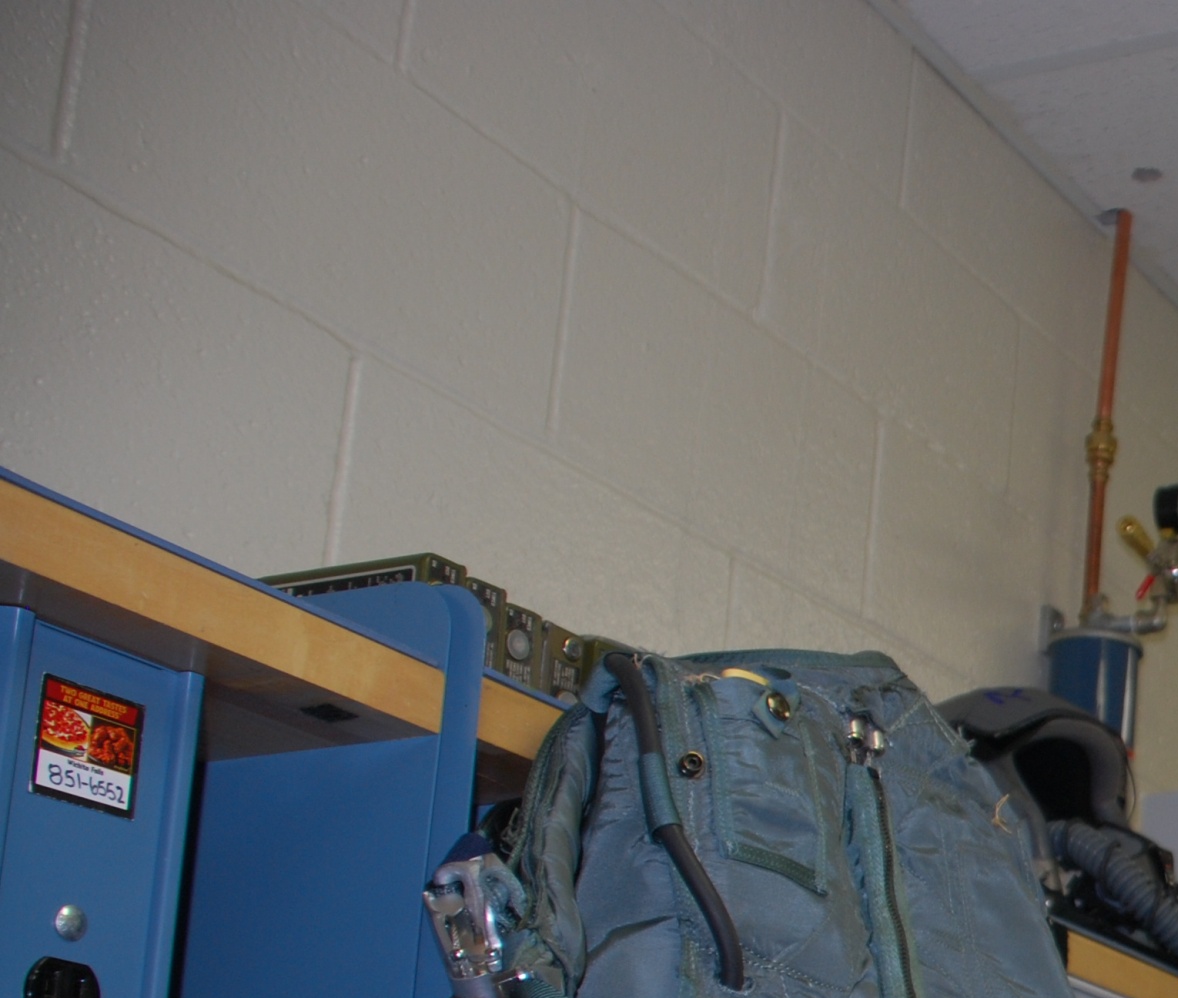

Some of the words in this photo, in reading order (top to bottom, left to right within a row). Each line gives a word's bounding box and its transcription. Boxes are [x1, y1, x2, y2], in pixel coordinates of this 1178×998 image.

[60, 685, 77, 697] TWO
[79, 691, 101, 705] GREAT
[103, 697, 128, 714] TASTES
[63, 695, 72, 704] AT
[74, 699, 89, 710] ONE
[67, 760, 90, 772] Wichita
[91, 766, 104, 776] Falls
[48, 764, 125, 804] 851-6552
